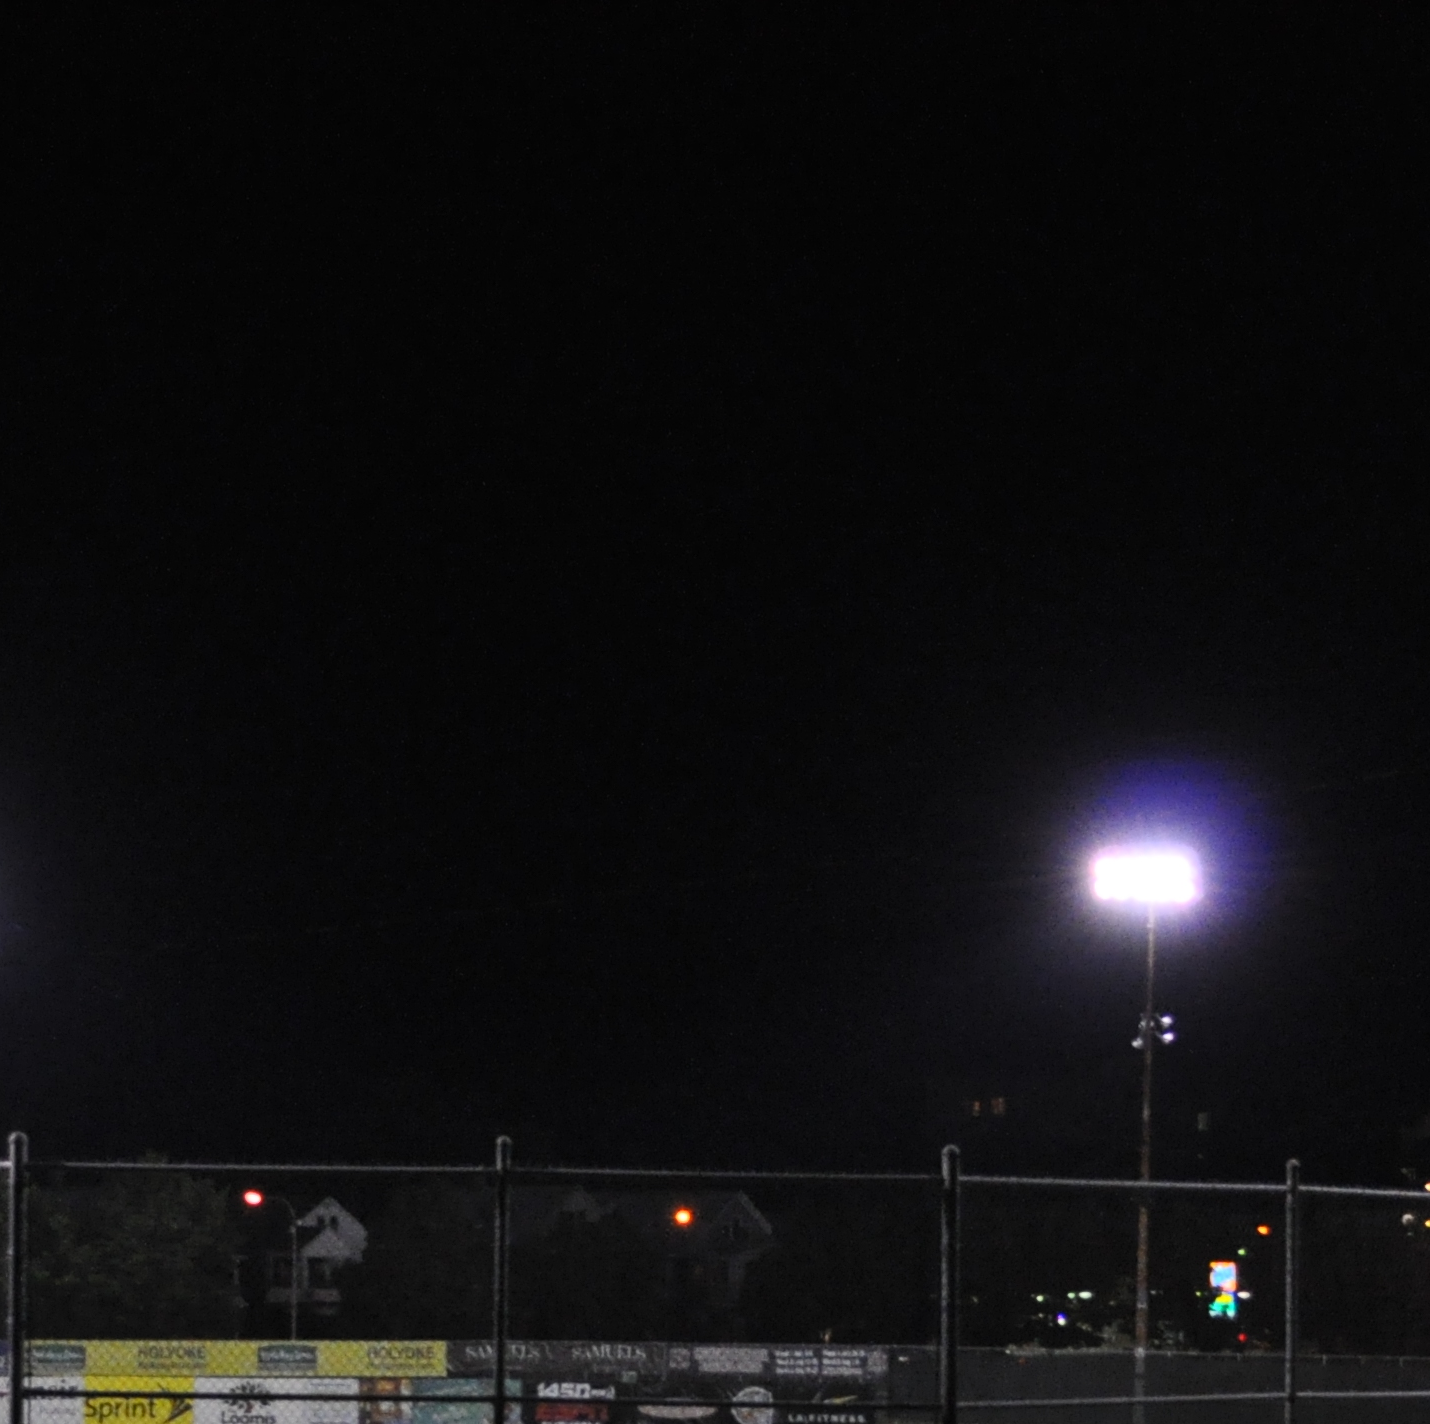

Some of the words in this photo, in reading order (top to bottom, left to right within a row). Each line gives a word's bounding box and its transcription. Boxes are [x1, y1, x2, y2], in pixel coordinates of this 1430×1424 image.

[137, 1346, 206, 1359] HOLYOKE
[466, 1344, 540, 1360] SAMELS
[85, 1398, 157, 1424] Sprint
[222, 1411, 276, 1424] Loomis
